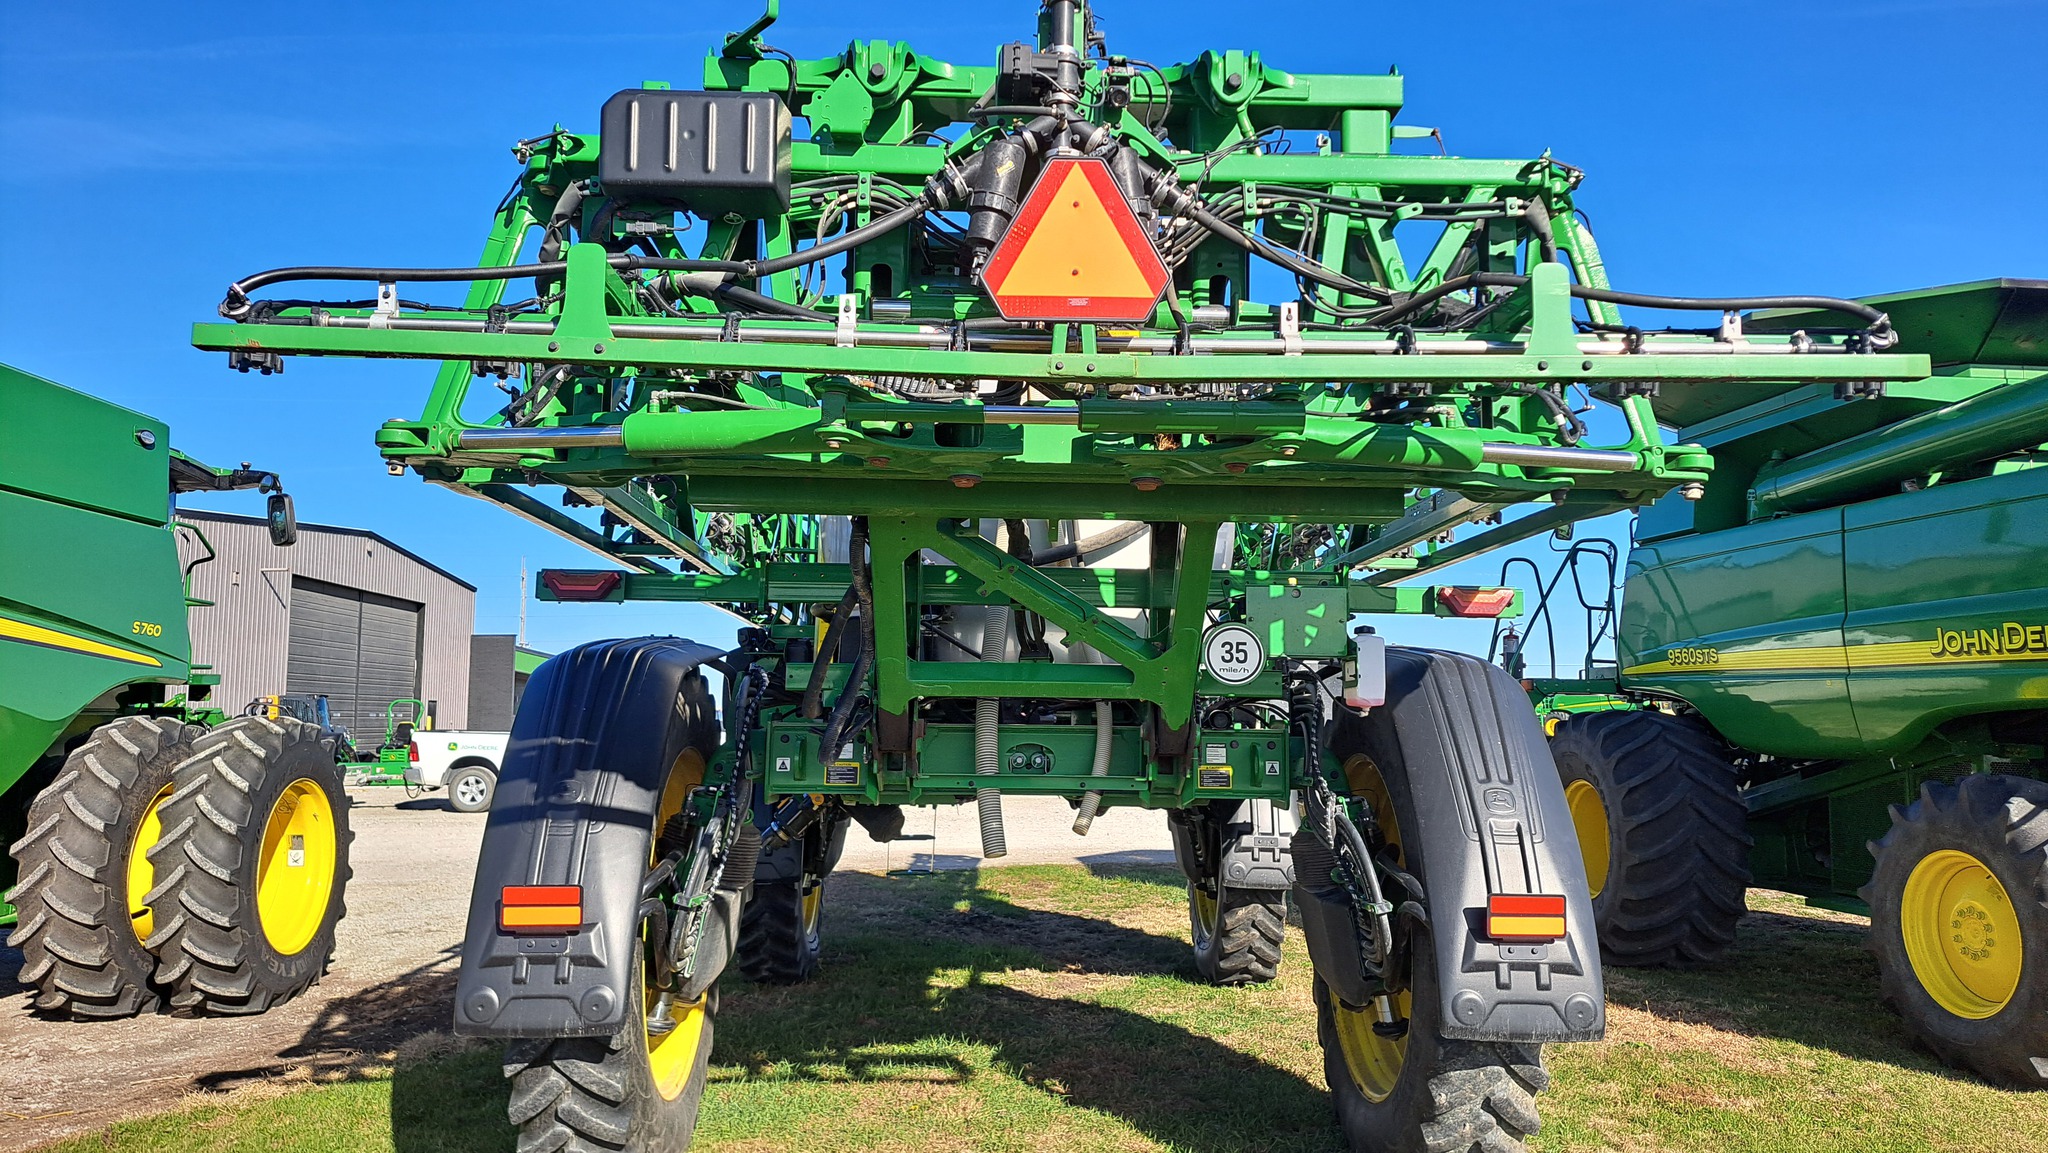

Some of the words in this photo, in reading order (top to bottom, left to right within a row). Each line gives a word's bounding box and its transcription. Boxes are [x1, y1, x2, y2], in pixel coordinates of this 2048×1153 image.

[132, 620, 162, 638] S760
[1930, 626, 2001, 656] JOHN
[2002, 621, 2048, 653] DE
[1220, 641, 1249, 664] 35
[1667, 647, 1719, 664] 9560STS
[1219, 666, 1250, 674] mile/h
